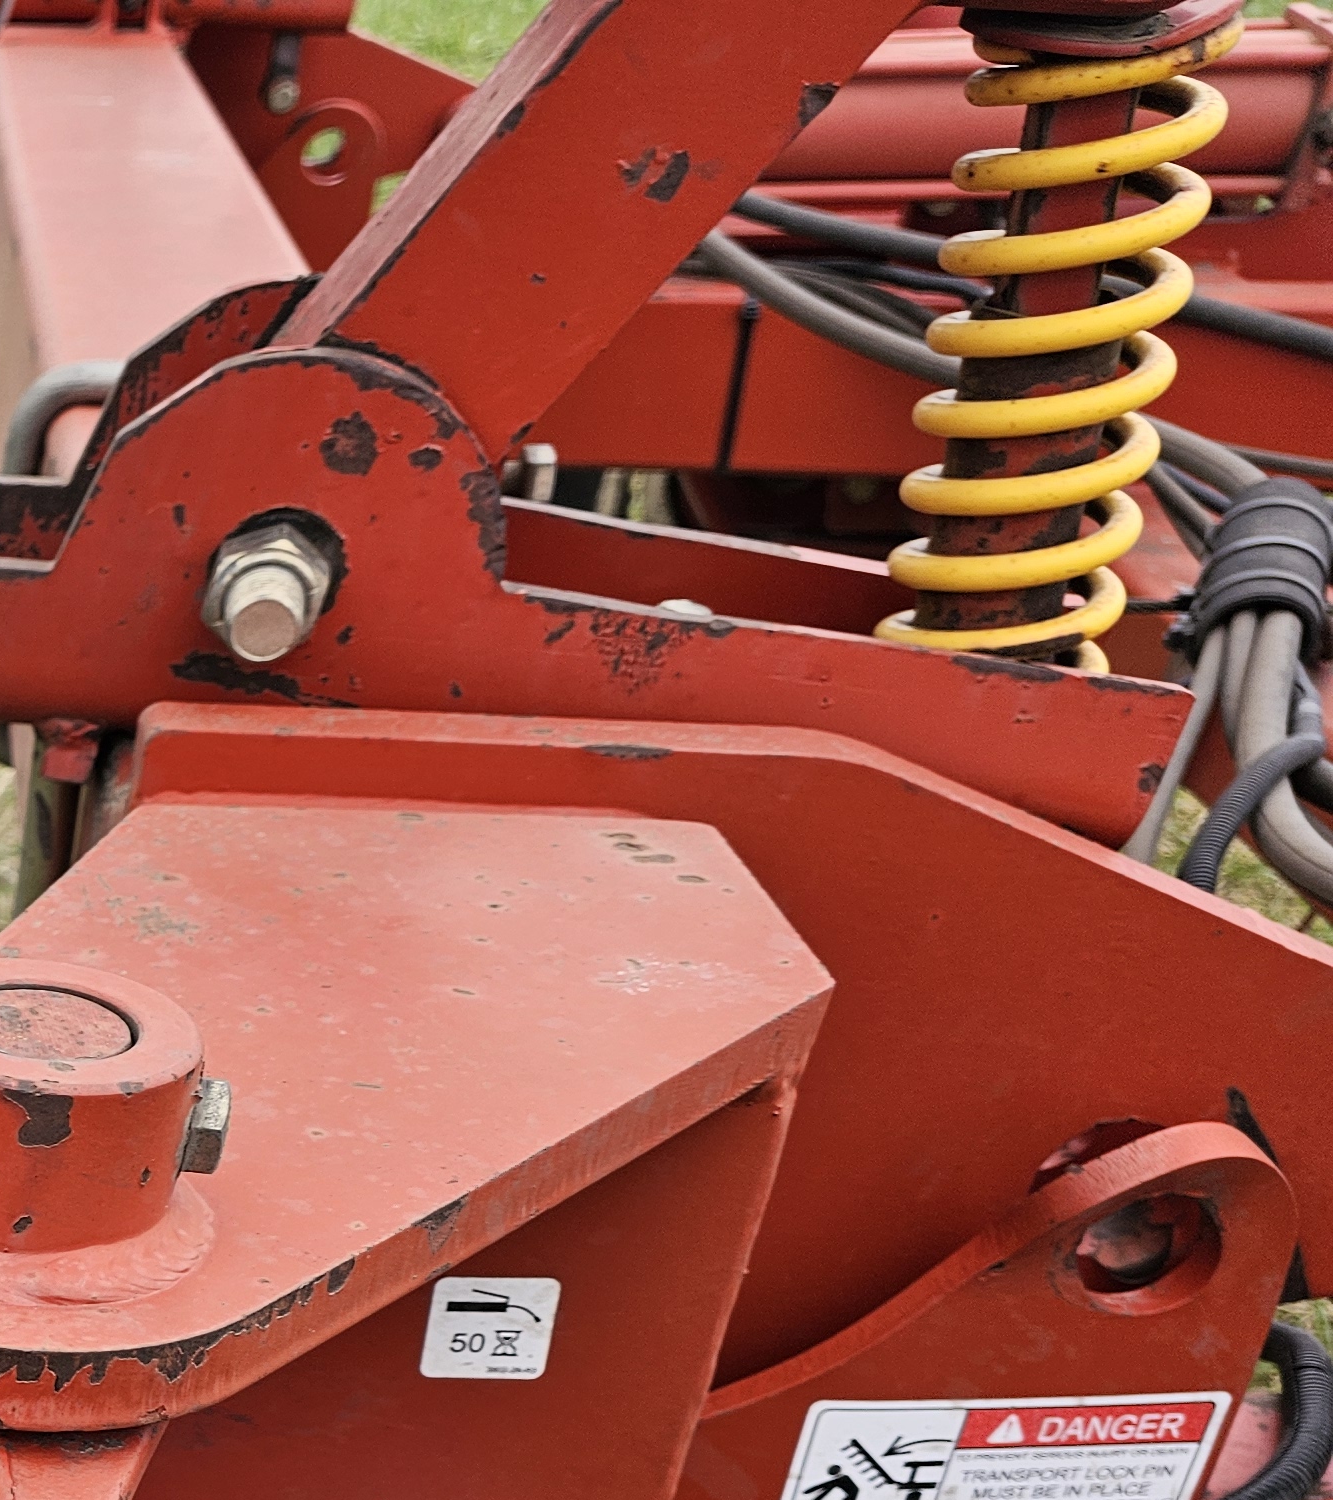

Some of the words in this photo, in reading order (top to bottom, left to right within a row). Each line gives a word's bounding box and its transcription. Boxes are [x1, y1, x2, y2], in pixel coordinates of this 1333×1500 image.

[449, 1333, 485, 1353] 50
[1037, 1412, 1186, 1442] DANGER
[961, 1467, 1081, 1482] TRANSPORT
[1085, 1465, 1139, 1480] LOCK
[1144, 1464, 1174, 1477] PIN
[973, 1486, 1029, 1499] MUST
[1031, 1485, 1059, 1497] BE
[1064, 1484, 1082, 1496] IN
[1088, 1482, 1151, 1496] PLACE
